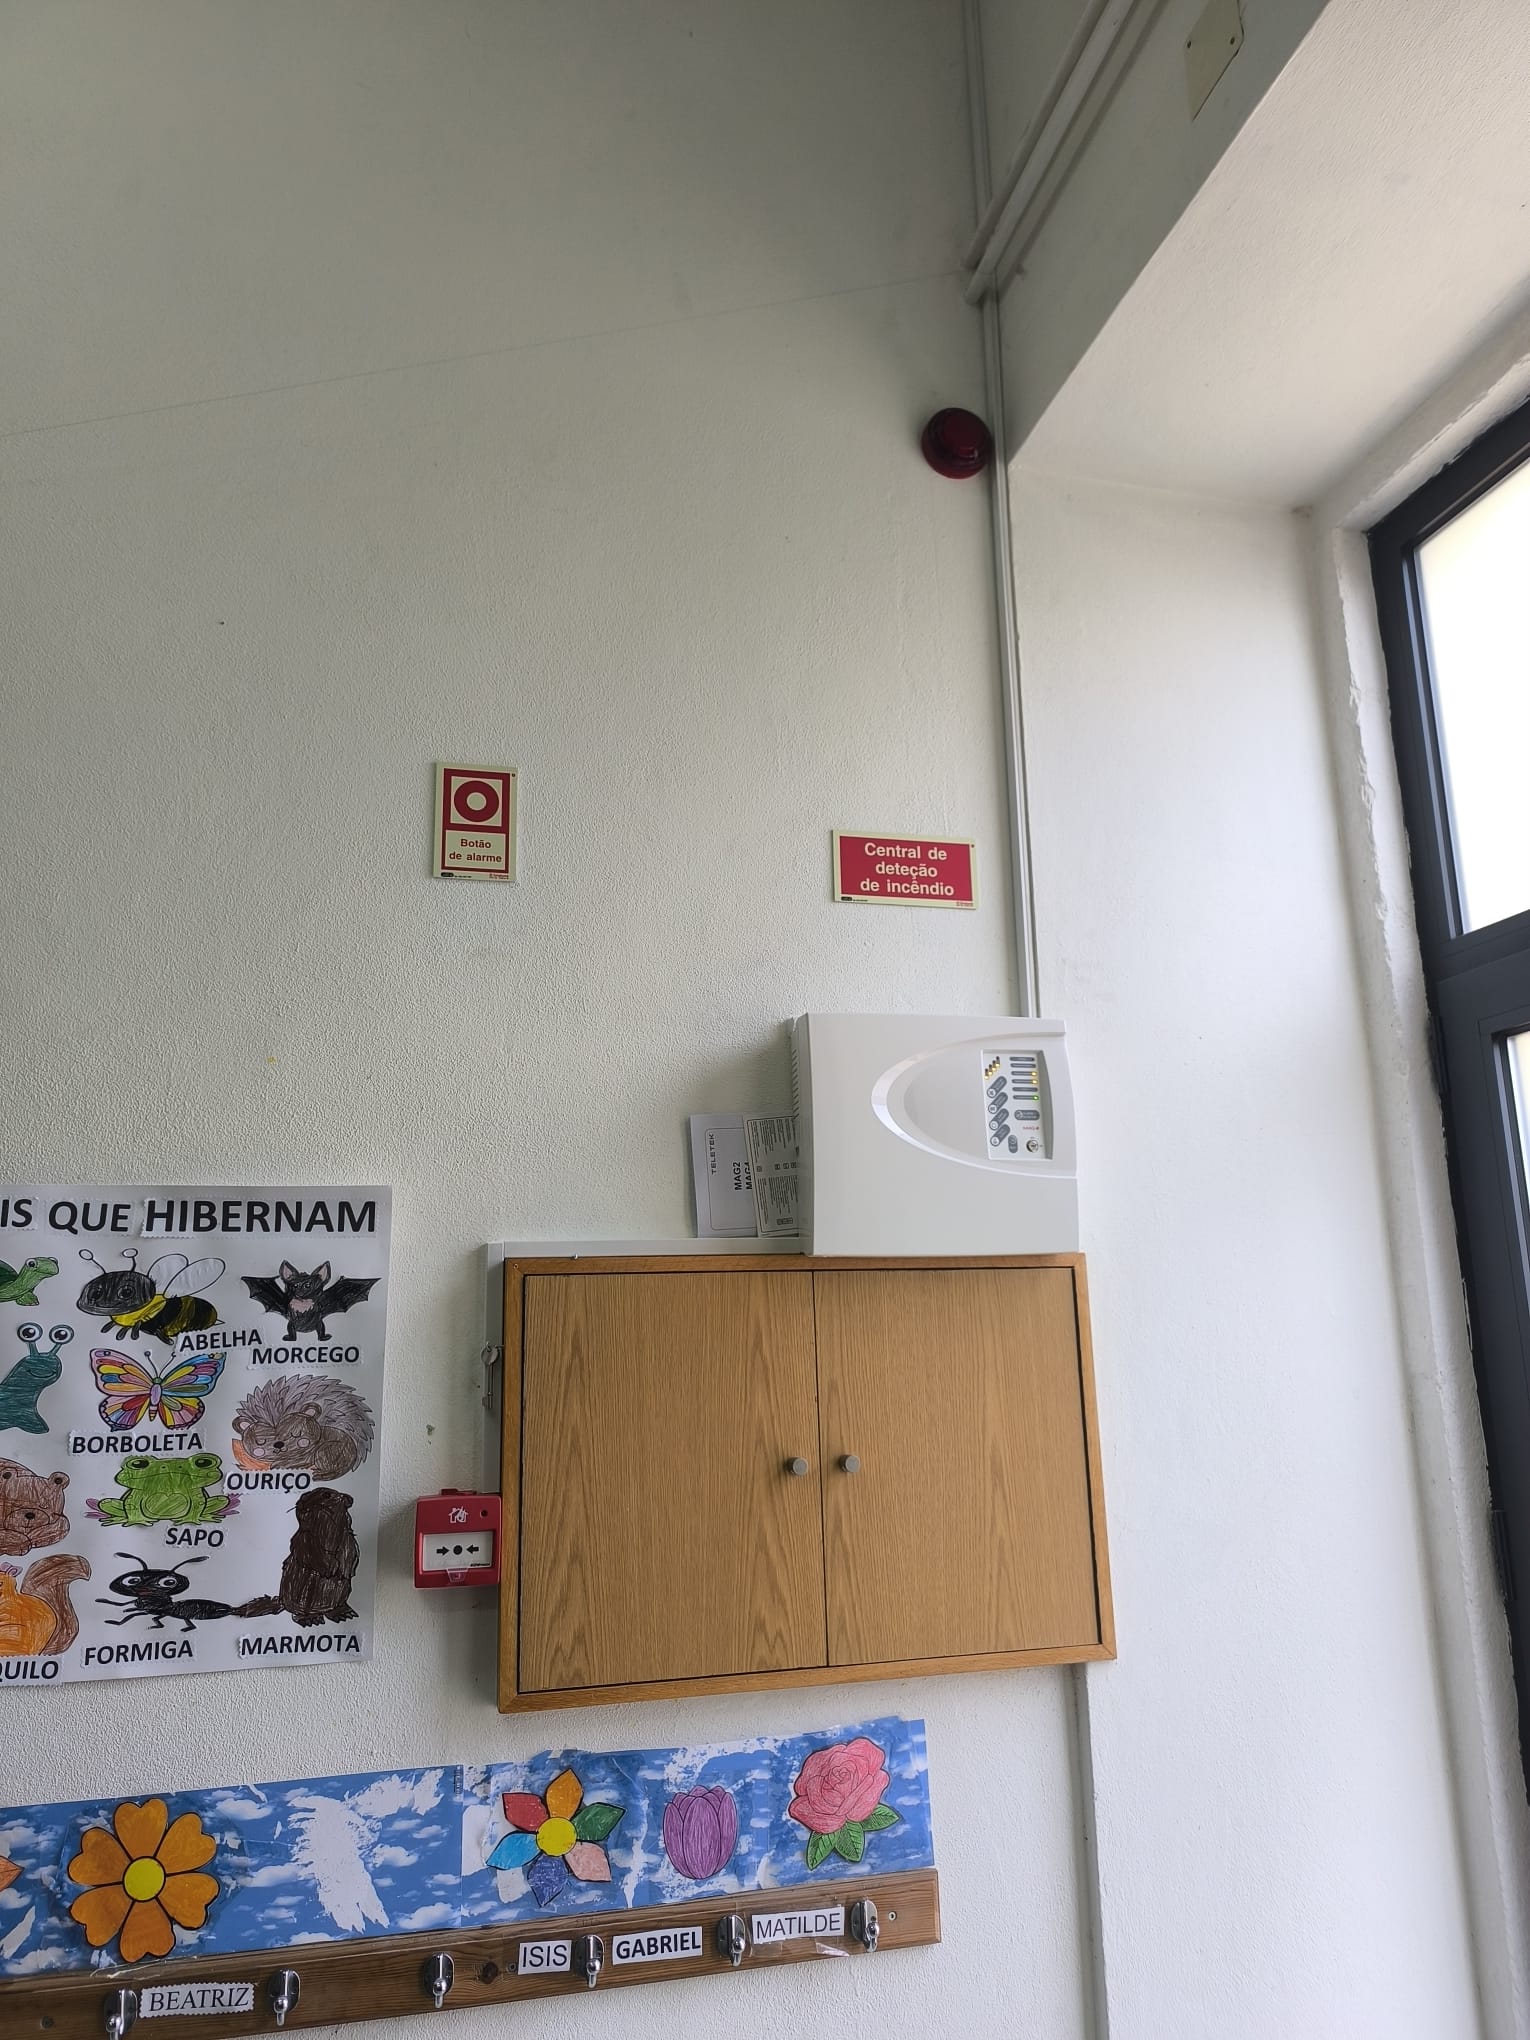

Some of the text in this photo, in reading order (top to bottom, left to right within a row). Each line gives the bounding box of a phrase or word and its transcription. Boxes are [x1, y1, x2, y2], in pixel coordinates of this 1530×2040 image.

[460, 838, 492, 849] Botão
[864, 842, 948, 861] Central de
[449, 851, 502, 863] de alarme
[875, 861, 938, 880] deteção
[860, 878, 954, 896] de incêndio
[708, 1133, 717, 1175] TELETEK
[732, 1161, 742, 1191] MAG2
[49, 1201, 131, 1235] QUE
[145, 1199, 376, 1233] HIBERNAM
[179, 1329, 263, 1352] ABELHA
[252, 1346, 360, 1366] MORCEGO
[71, 1433, 203, 1454] BORBOLETA
[226, 1473, 311, 1494] OURIÇO
[165, 1527, 225, 1547] SAPO
[84, 1640, 194, 1666] FORMIGA
[241, 1635, 361, 1656] MARMOTA
[0, 1660, 59, 1683] UILO
[756, 1913, 842, 1938] MATILDE
[522, 1944, 568, 1969] ISIS
[615, 1932, 701, 1960] GABRIEL
[149, 1987, 250, 2012] BEATRIZ
